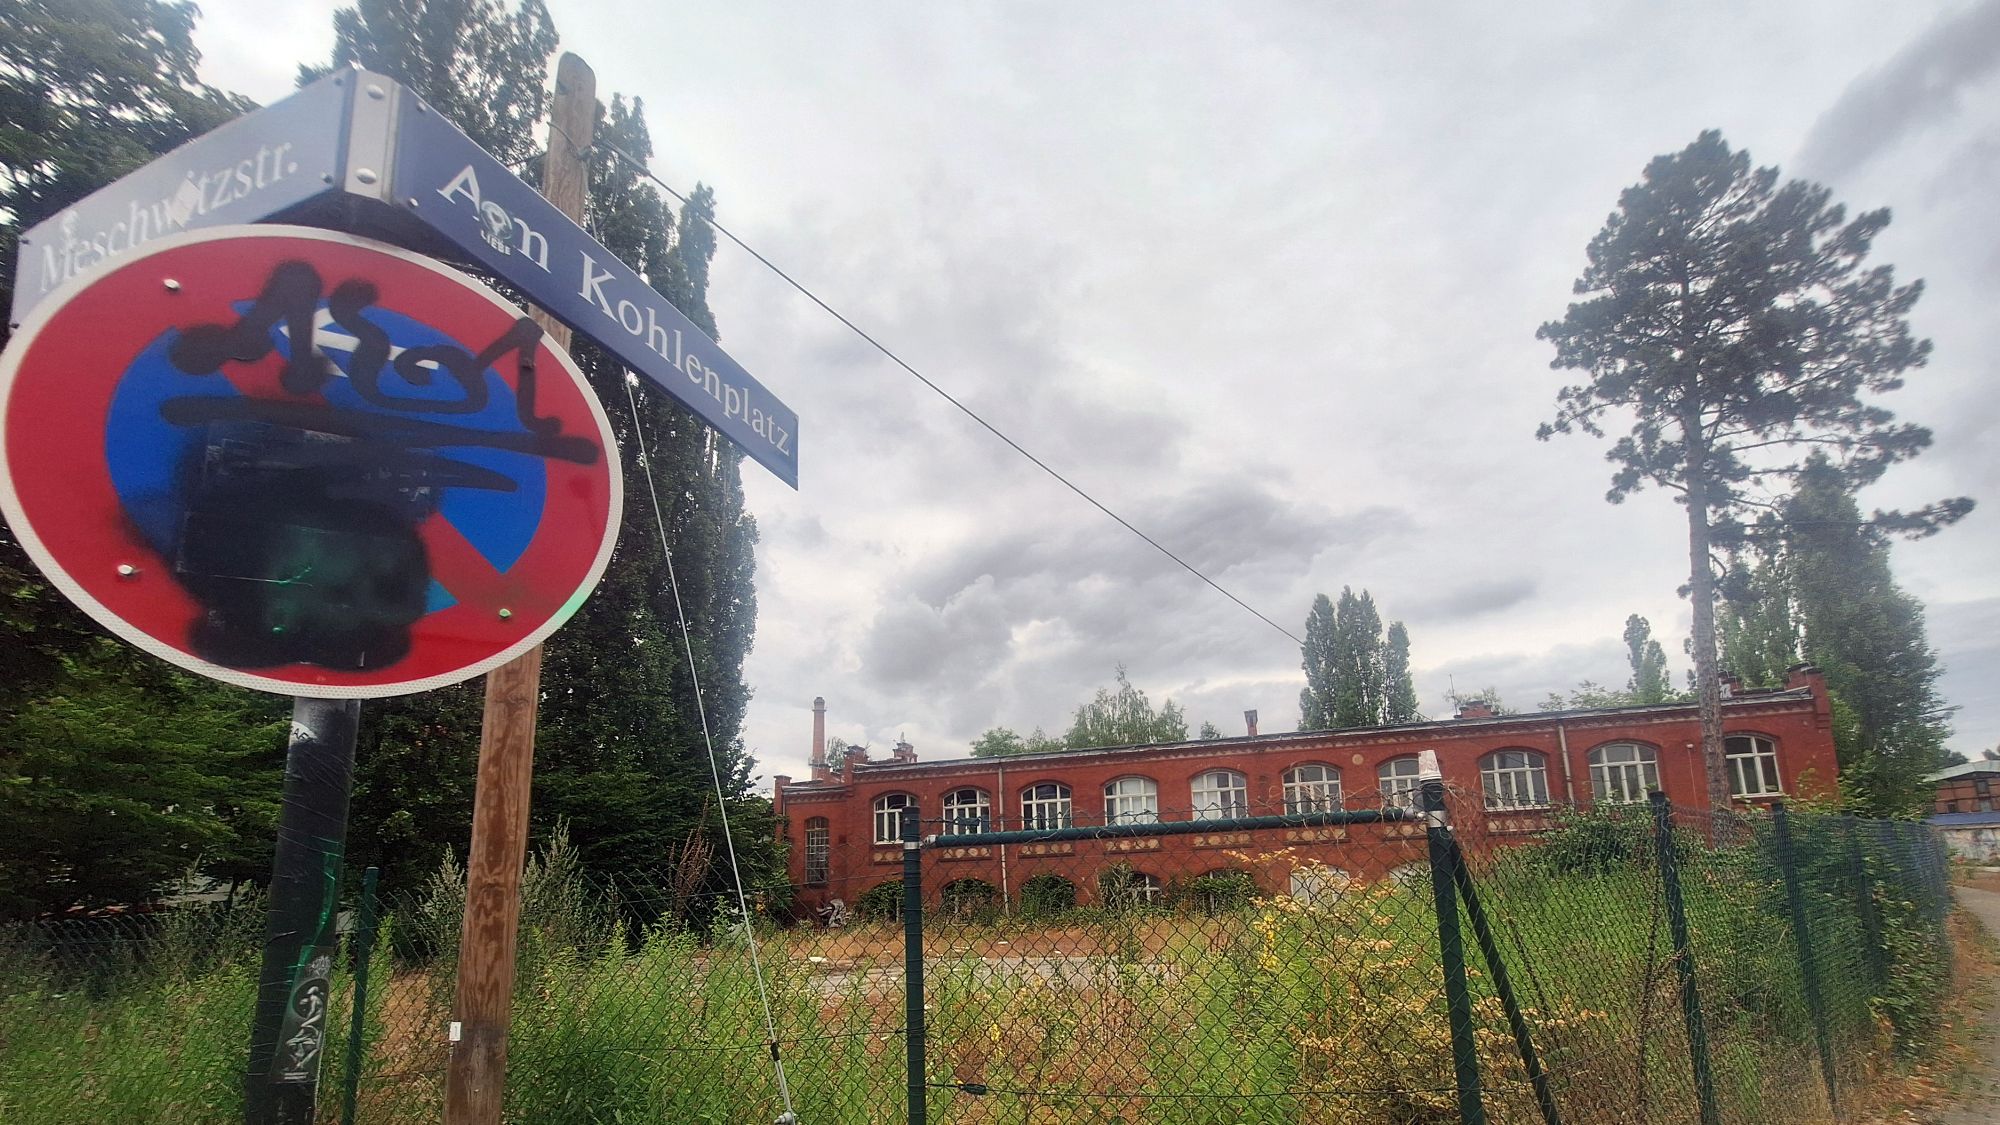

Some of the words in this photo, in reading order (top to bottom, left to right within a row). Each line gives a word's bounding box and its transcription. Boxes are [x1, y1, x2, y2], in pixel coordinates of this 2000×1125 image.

[39, 141, 298, 292] Meschwtzstr.
[480, 229, 511, 256] LIEBE
[436, 164, 552, 274] Am
[577, 250, 790, 457] Kohlenplatz
